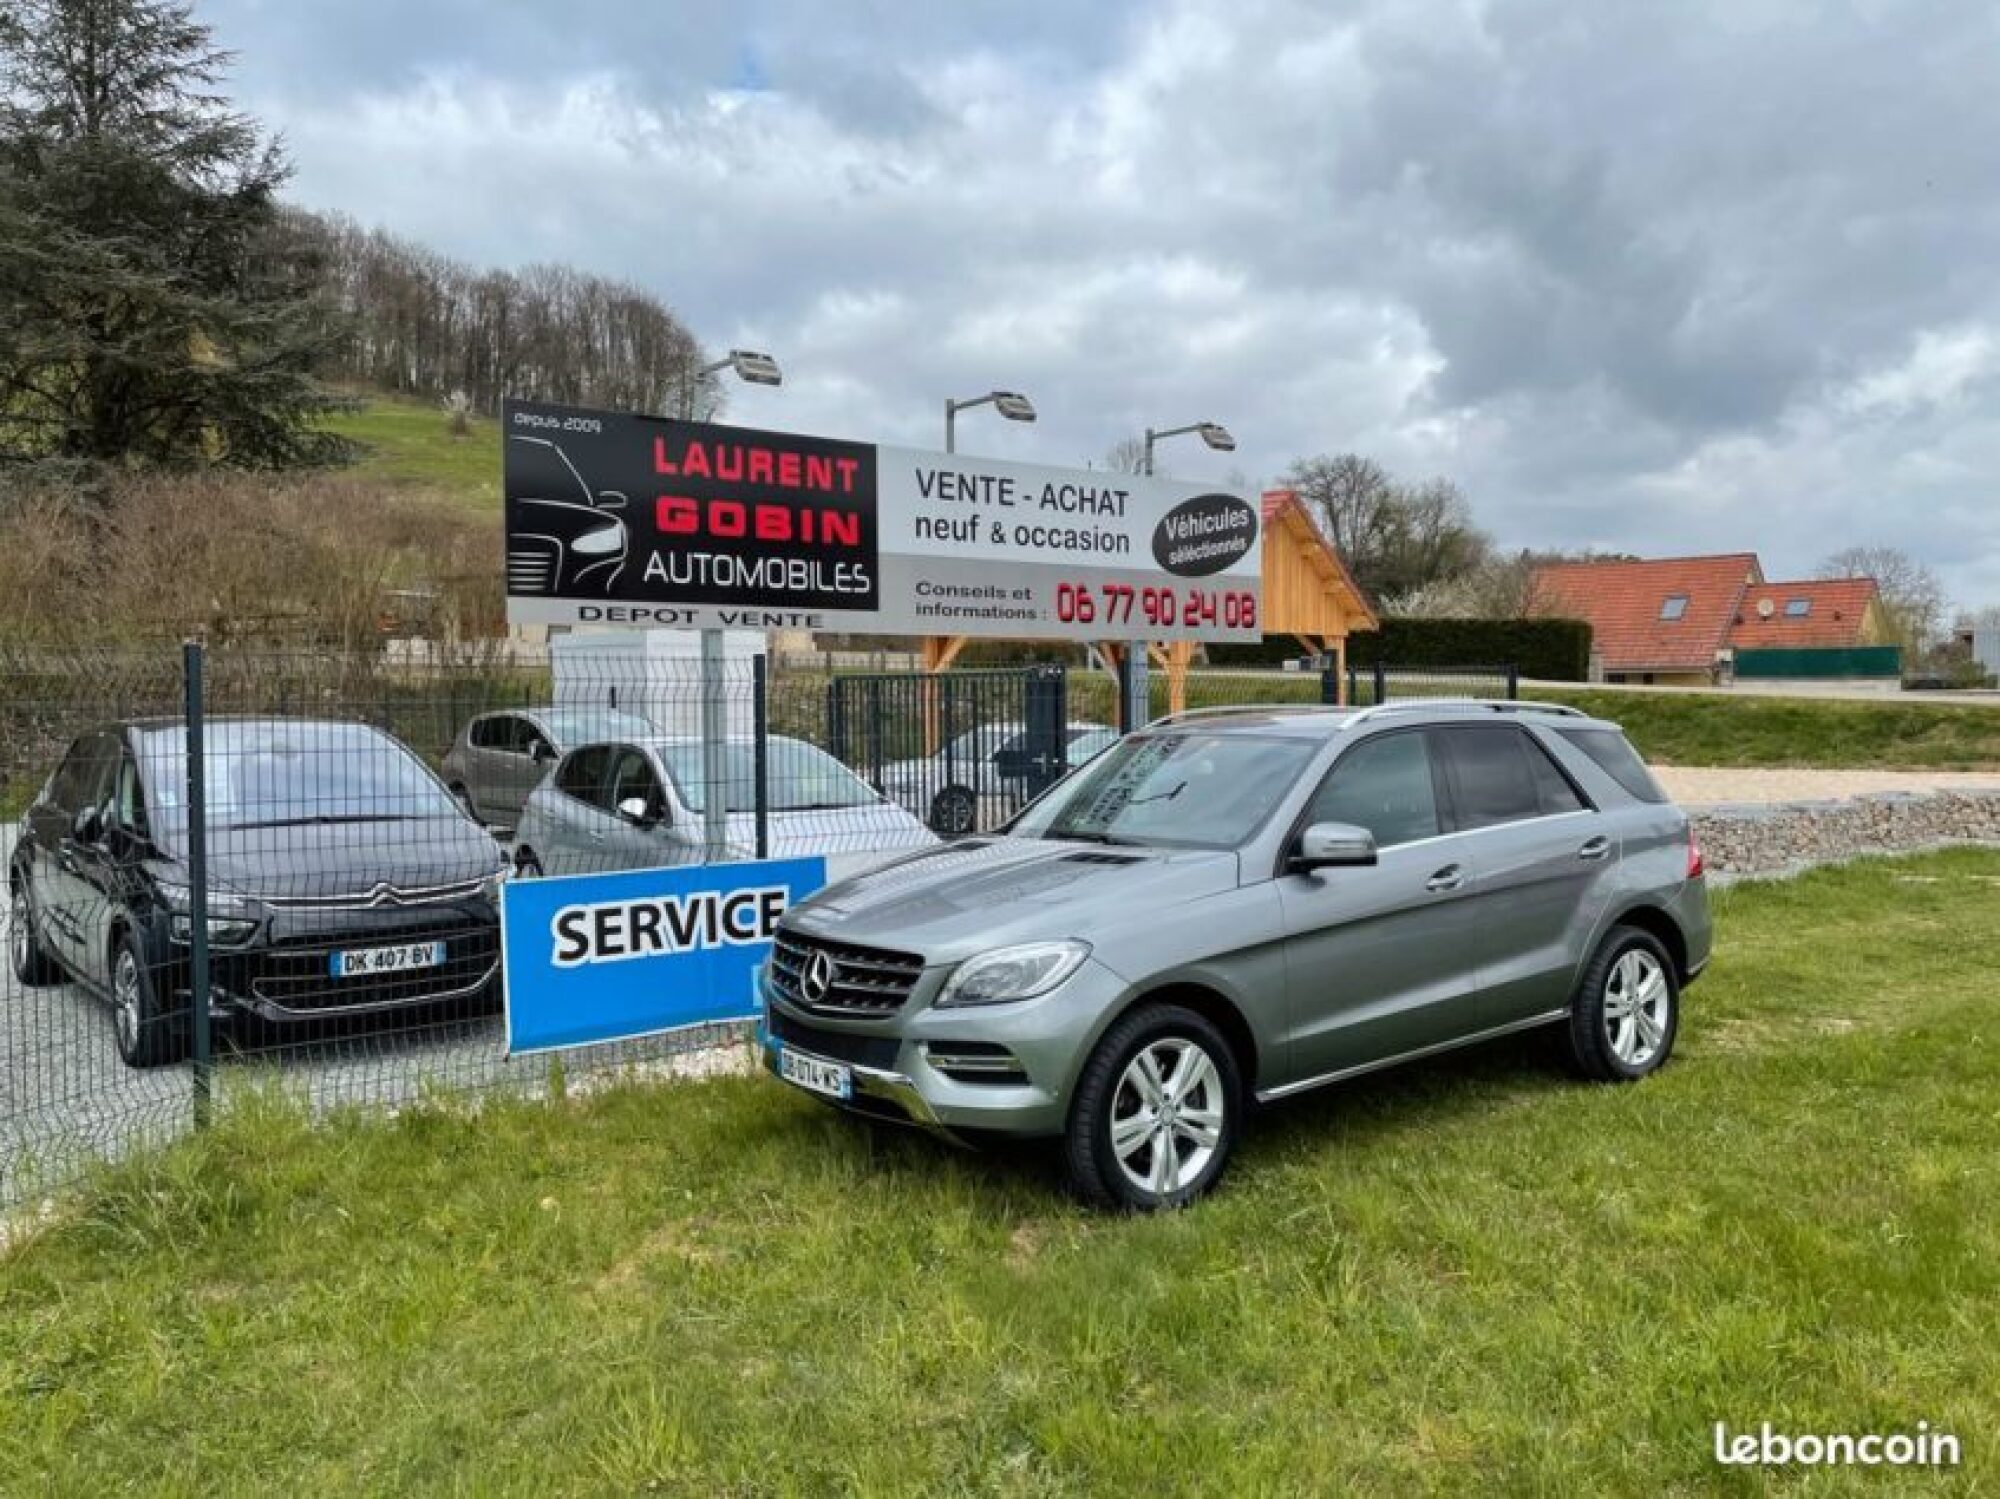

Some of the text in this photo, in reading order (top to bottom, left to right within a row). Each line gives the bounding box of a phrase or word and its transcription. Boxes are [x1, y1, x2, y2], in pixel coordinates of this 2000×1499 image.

[654, 437, 858, 492] LAURENT
[915, 468, 1016, 506] VENTE
[1039, 483, 1129, 517] ACHAT
[655, 496, 860, 546] GOBIN
[915, 514, 1129, 554] neuf & occasion
[1165, 506, 1248, 540] Véhicules
[644, 550, 871, 594] AUTOMOBILES
[915, 581, 1032, 600] Conseils et
[578, 606, 823, 629] DEPOT VENTE
[915, 602, 1036, 620] informations
[1056, 582, 1094, 623] 06
[1102, 585, 1135, 624] 77
[1142, 587, 1175, 626] 90
[1182, 590, 1217, 627] 24
[556, 891, 785, 961] SERVICE
